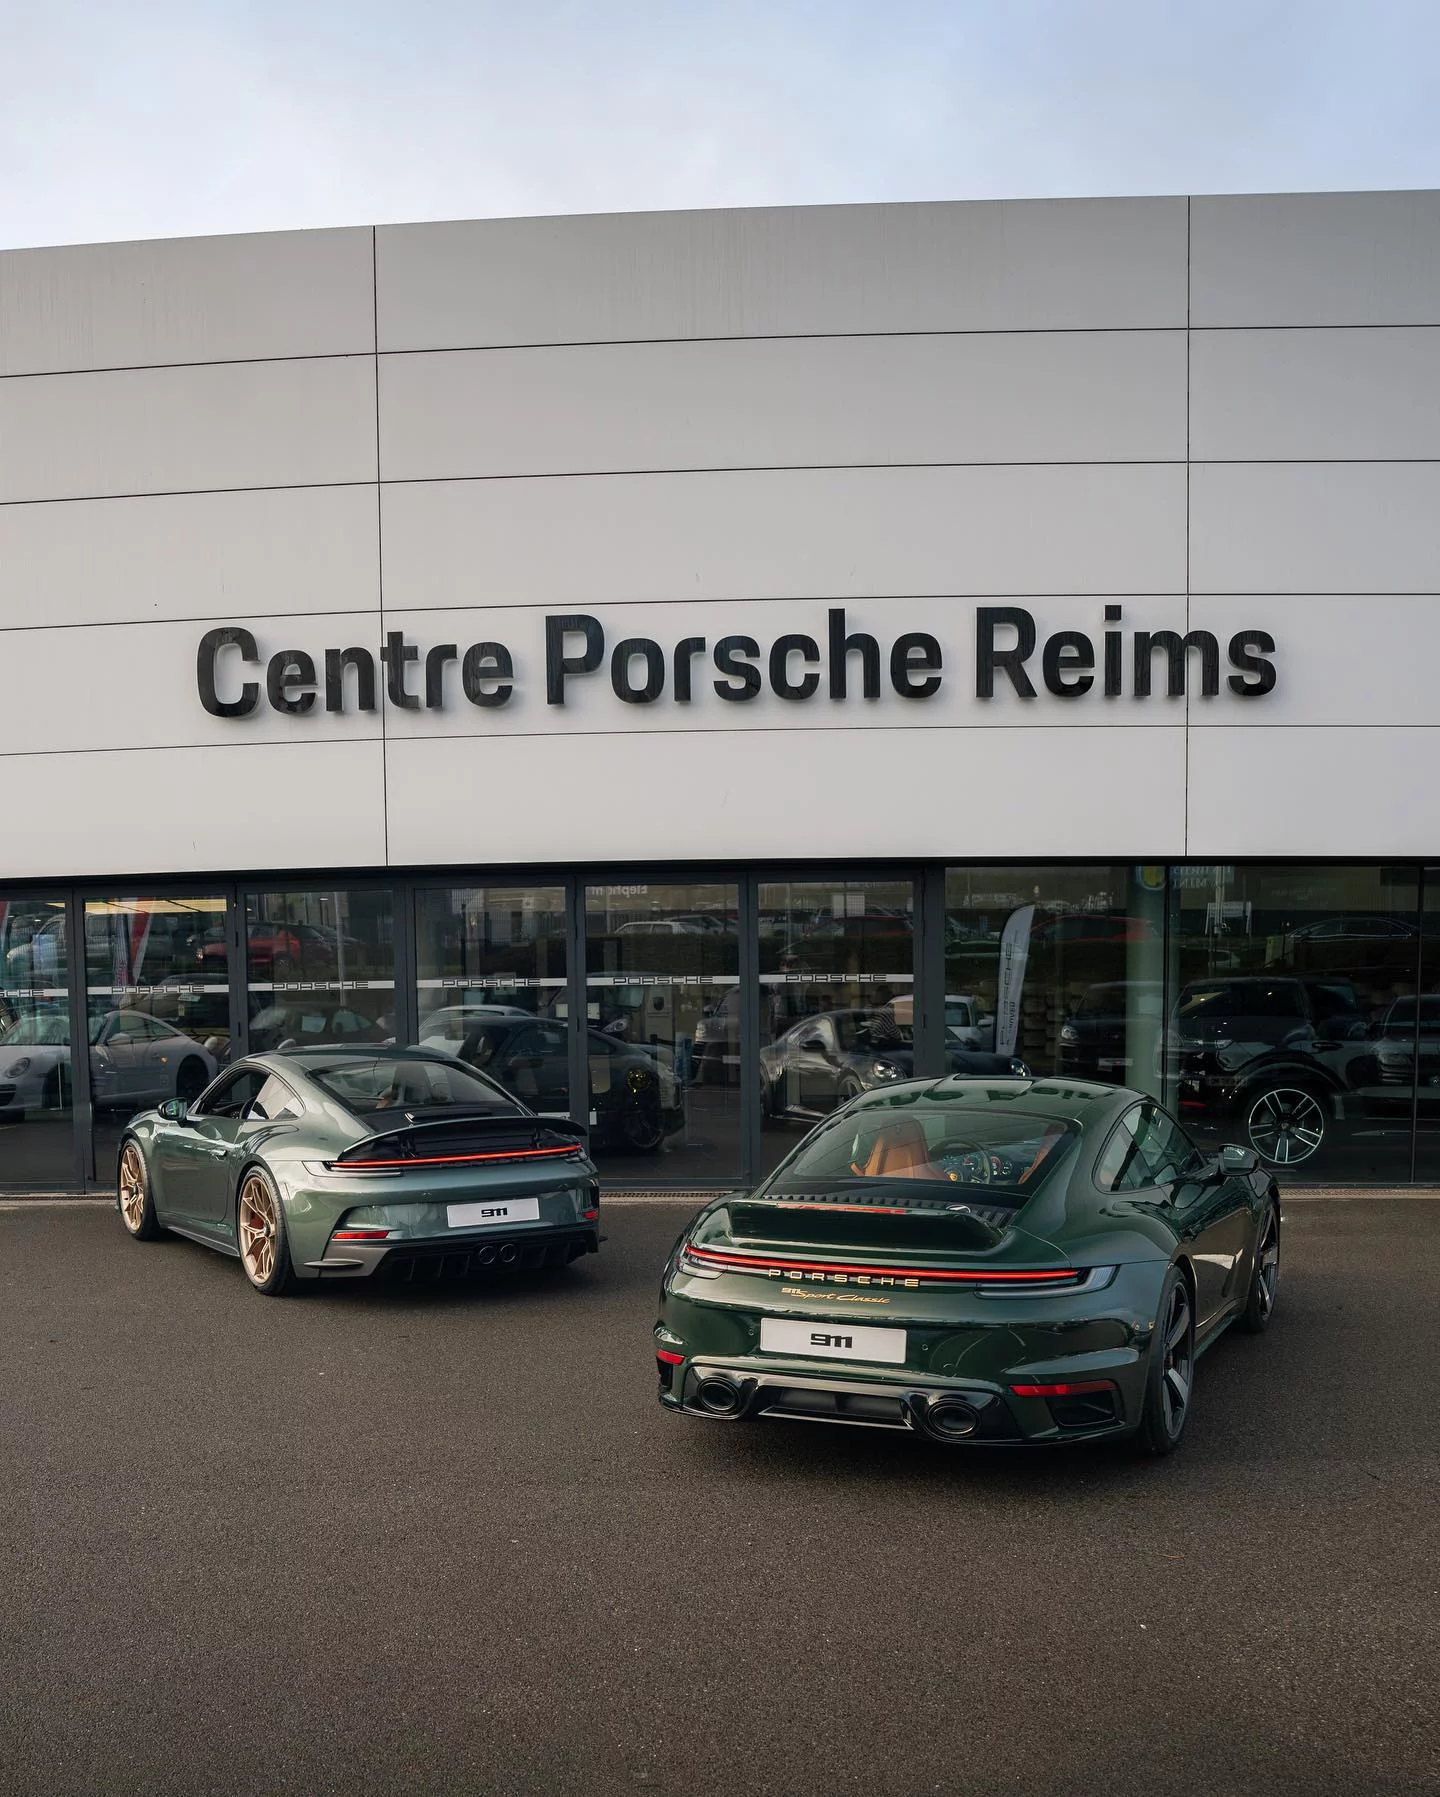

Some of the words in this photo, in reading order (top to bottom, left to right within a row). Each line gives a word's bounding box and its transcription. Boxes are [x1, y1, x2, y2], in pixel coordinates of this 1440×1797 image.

[197, 627, 514, 717] Centre
[546, 608, 943, 705] Porsche
[976, 605, 1276, 697] Reims
[613, 976, 713, 985] PORSCHE
[786, 973, 887, 982] PORSCHE
[272, 981, 369, 990] PORSCHE
[442, 978, 541, 987] PORSCHE
[112, 985, 205, 994] PORSCHE
[481, 1207, 508, 1218] 911
[768, 1268, 920, 1287] PORSCHE
[781, 1287, 802, 1295] 911
[791, 1290, 836, 1300] Sport
[837, 1294, 891, 1304] Classic
[810, 1333, 853, 1349] 911
